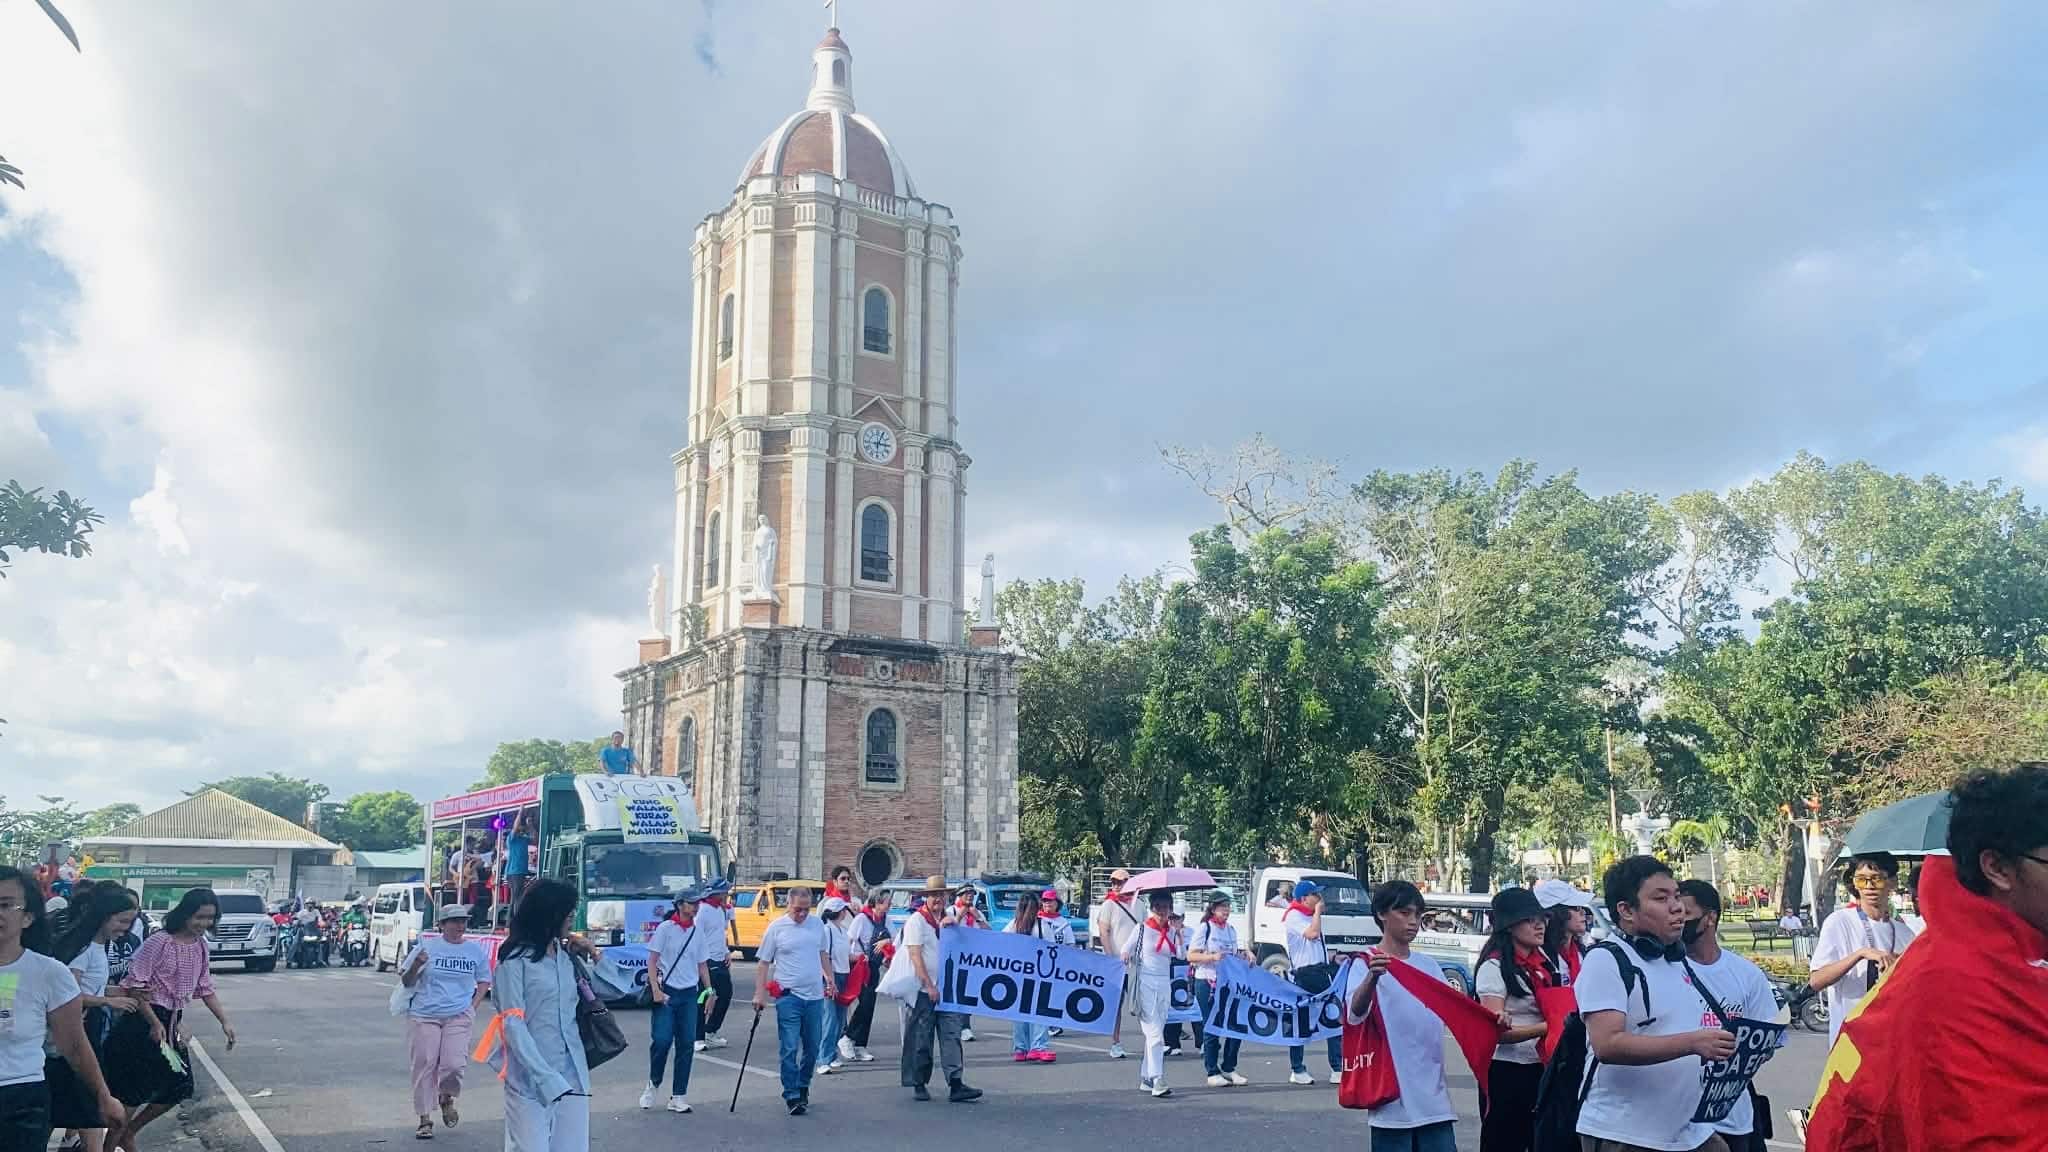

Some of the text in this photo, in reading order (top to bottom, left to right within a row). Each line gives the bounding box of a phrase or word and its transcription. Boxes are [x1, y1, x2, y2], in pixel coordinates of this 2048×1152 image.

[626, 805, 674, 813] WALANG
[629, 820, 678, 828] WALANG
[942, 953, 1105, 1023] ILOILO
[1212, 981, 1343, 1038] ILOILO
